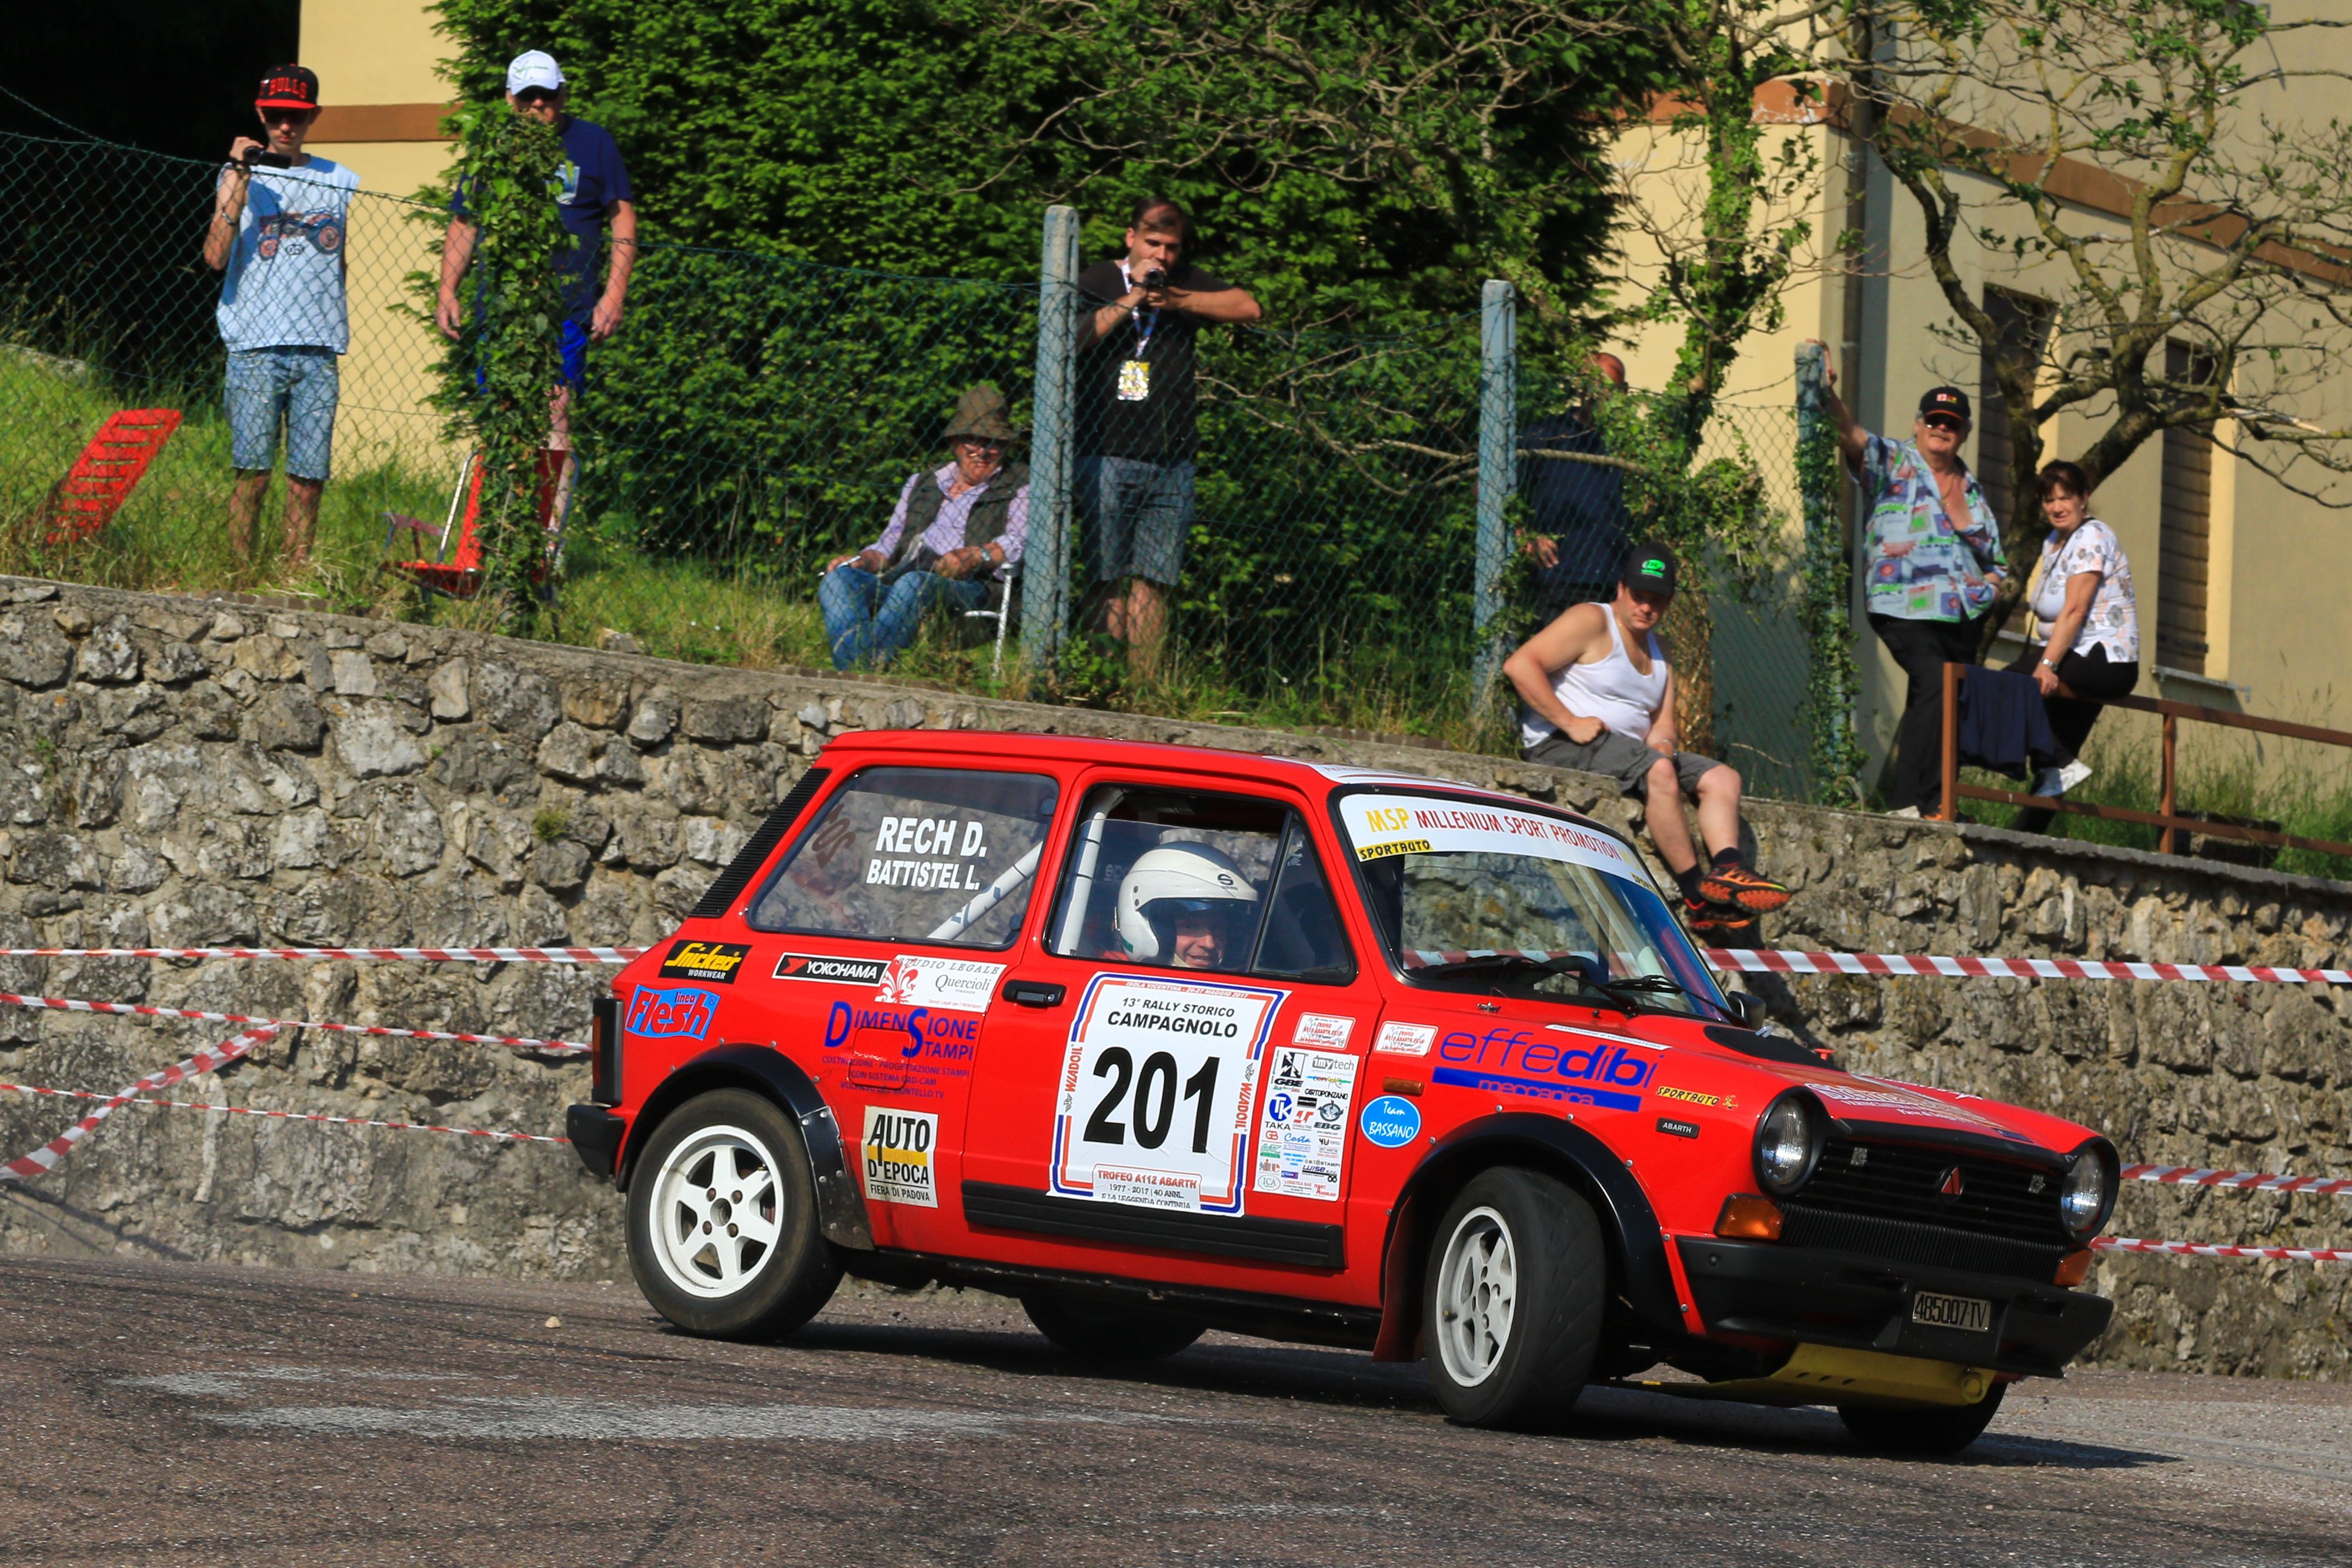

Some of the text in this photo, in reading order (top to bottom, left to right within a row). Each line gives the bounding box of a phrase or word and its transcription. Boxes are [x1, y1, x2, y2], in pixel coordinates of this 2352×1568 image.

[269, 77, 307, 99] BULLS
[875, 817, 987, 858] RECH D.
[1364, 807, 1410, 833] MSP
[1414, 810, 1505, 834] MILLENIUM
[1505, 815, 1548, 839] SPORT
[1549, 824, 1622, 861] PROMOTION
[1359, 840, 1431, 860] SPORTAUTO
[866, 858, 980, 890] BATTISTEL L.
[687, 968, 726, 980] WORKWEAR
[806, 960, 878, 979] YOKOHAMA
[898, 957, 1000, 975] STUDIO LEGALE
[935, 974, 992, 992] Quercioli
[1147, 984, 1181, 992] VICENTINA
[1204, 989, 1232, 997] MAGGIO
[674, 991, 696, 1003] linea
[1122, 997, 1235, 1018] 13° RALLY STORICO
[1107, 1011, 1238, 1038] CAMPAGNOLO
[850, 1069, 937, 1086] CON SISTEMA CAD-CAM
[879, 1059, 941, 1075] PROGETTAZIONE
[941, 1067, 970, 1078] STAMPI
[934, 1089, 944, 1099] TV
[1083, 1046, 1221, 1154] 201
[1656, 1086, 1720, 1106] SPORTAUTO
[1384, 1101, 1405, 1116] Team
[867, 1114, 931, 1154] AUTO
[1265, 1121, 1291, 1131] TAKA
[1314, 1122, 1342, 1131] EBG
[1368, 1121, 1414, 1139] BASSANO
[1662, 1121, 1692, 1134] ABARTH
[1284, 1132, 1311, 1144] Costa
[868, 1158, 930, 1185] D'EPOCA
[1097, 1169, 1197, 1189] TROFEO A112 ABARTH
[1110, 1183, 1126, 1192] 1977
[1132, 1186, 1149, 1195] 2017
[1153, 1188, 1164, 1196] 40
[1262, 1177, 1277, 1186] ICA
[870, 1183, 931, 1202] FIERA DI PADOVA
[1914, 1293, 1989, 1329] 485007 TV
